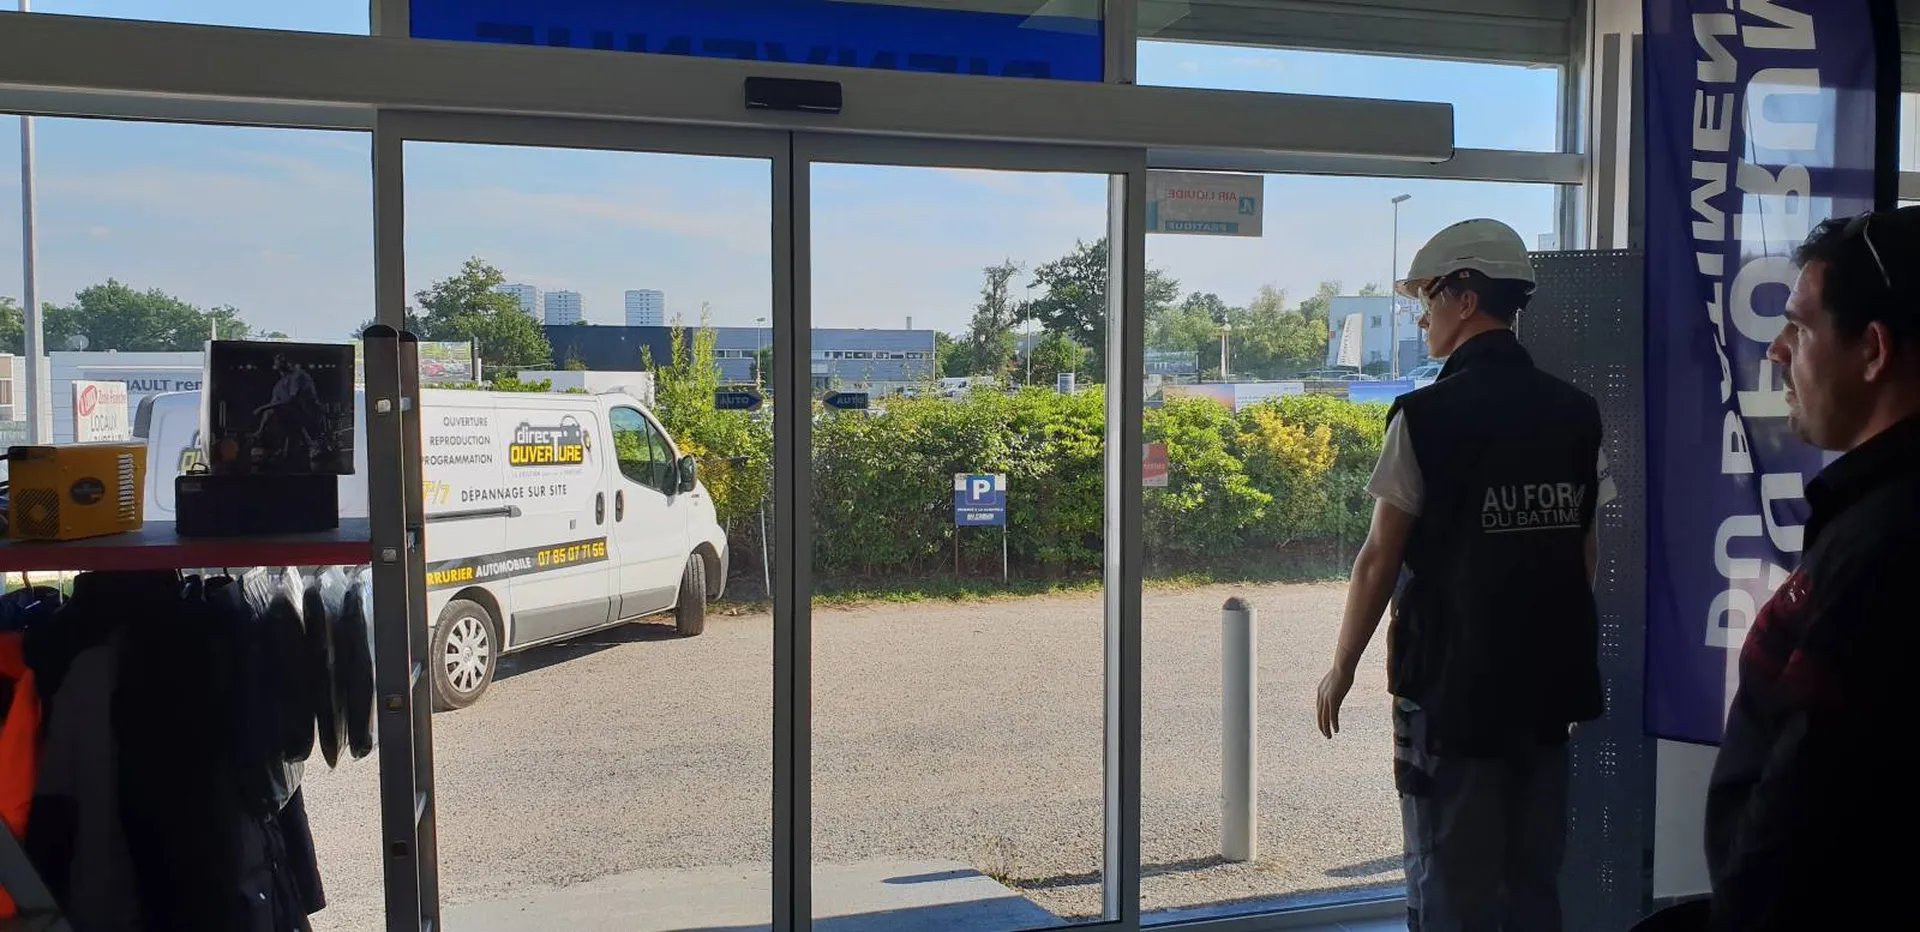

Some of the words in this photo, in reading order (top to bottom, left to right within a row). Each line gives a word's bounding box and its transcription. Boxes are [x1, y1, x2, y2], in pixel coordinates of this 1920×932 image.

[443, 416, 488, 427] OUVERTURE
[430, 435, 491, 446] REPRODUCTION
[510, 444, 582, 463] OUVERTURE
[461, 486, 524, 503] DÉPANNAGE
[528, 485, 546, 498] SUR
[549, 483, 567, 496] SITE
[972, 479, 991, 500] P
[1482, 486, 1516, 512] AU
[1481, 512, 1512, 528] DU
[475, 556, 532, 578] AUTOMOBILE
[538, 550, 551, 567] 07
[568, 546, 580, 561] 07
